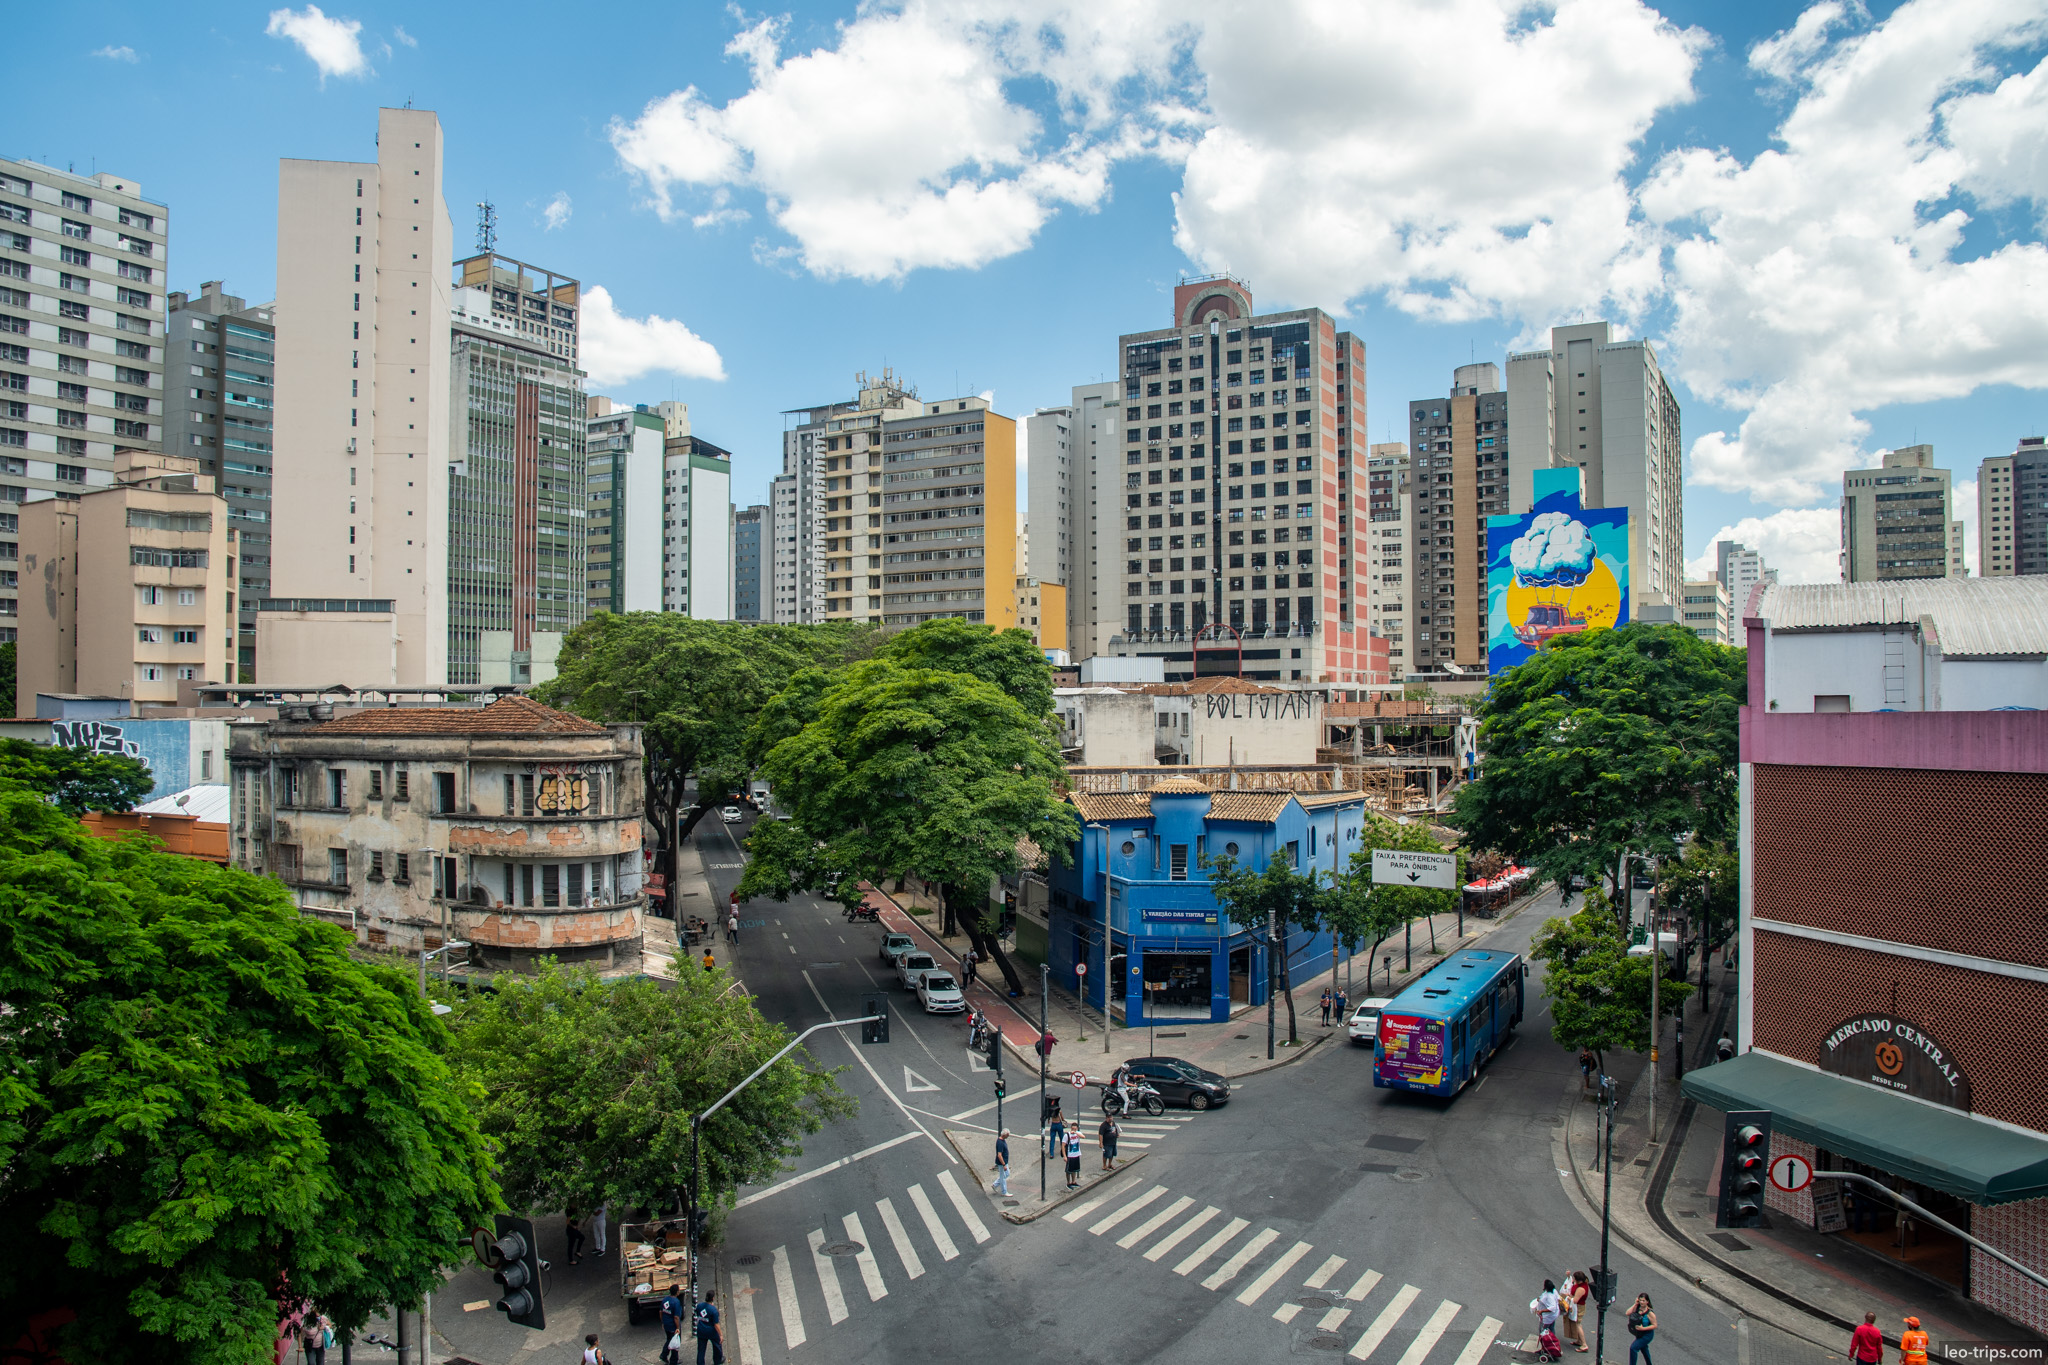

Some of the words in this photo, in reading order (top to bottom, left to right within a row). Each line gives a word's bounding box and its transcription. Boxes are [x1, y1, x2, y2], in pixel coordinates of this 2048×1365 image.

[1375, 852, 1396, 860] FAIXA
[1399, 854, 1452, 864] PREFERENCIAL
[1390, 861, 1409, 869] PARA
[1412, 862, 1438, 872] ÔNIBUS
[737, 919, 765, 929] MOV
[1428, 1043, 1438, 1051] 132
[1825, 1019, 1892, 1052] MERCADO
[1895, 1024, 1960, 1088] CENTRAL
[1872, 1075, 1892, 1086] DESDE
[1893, 1081, 1908, 1090] 1929
